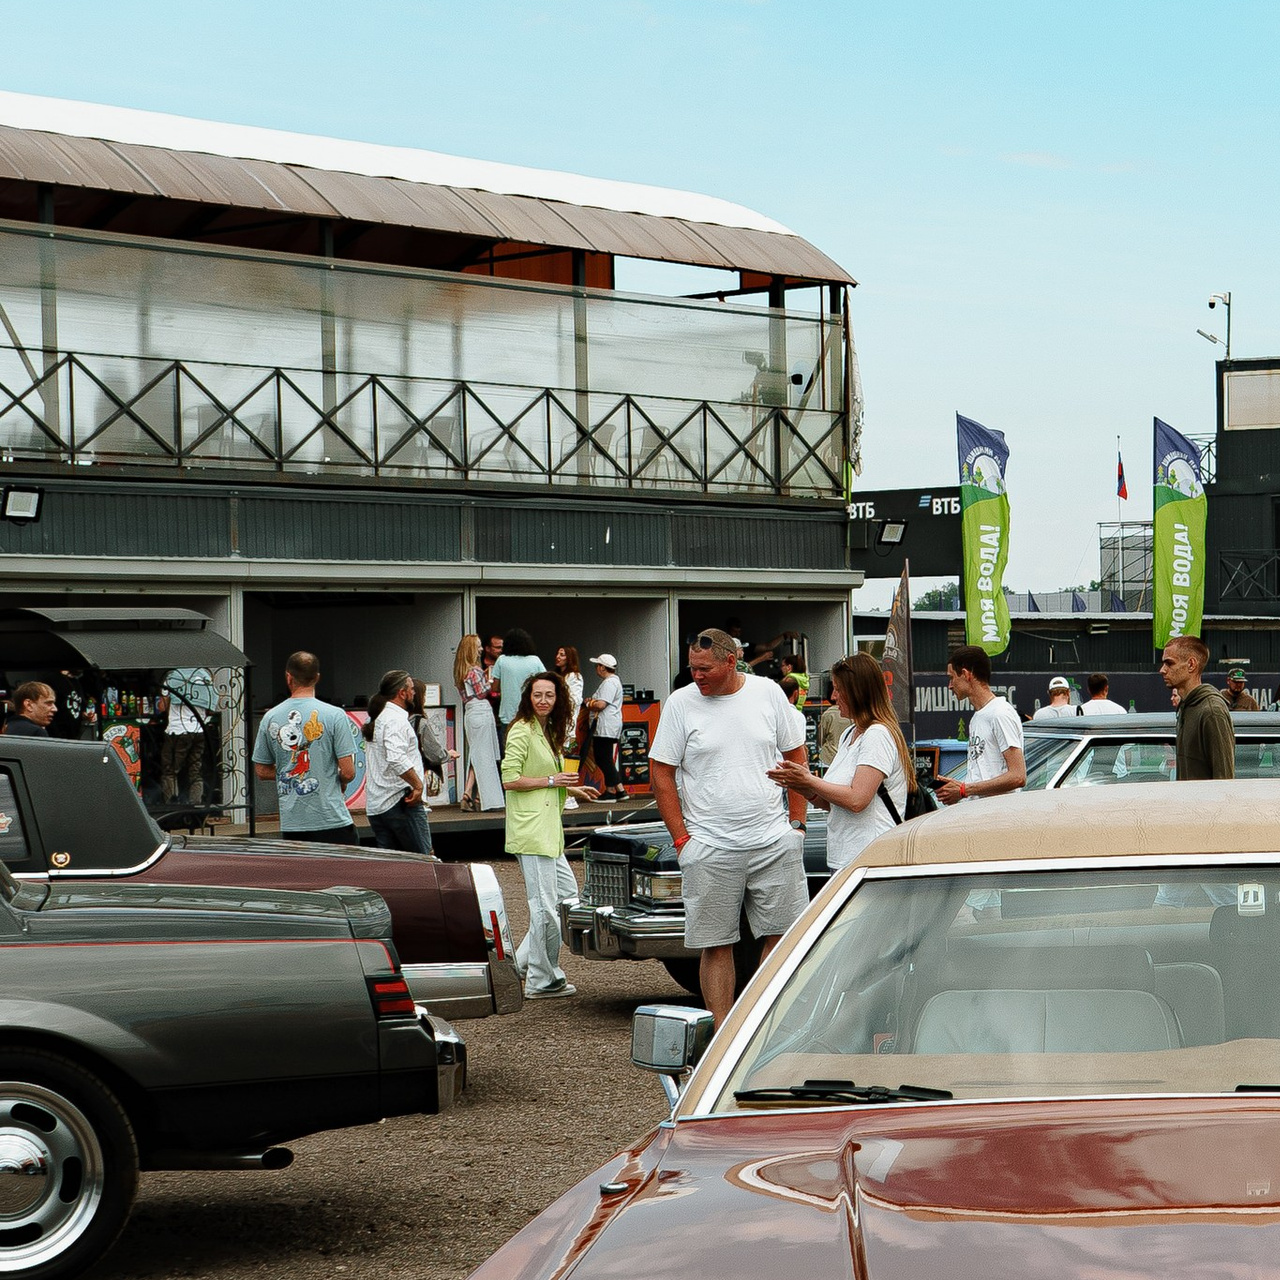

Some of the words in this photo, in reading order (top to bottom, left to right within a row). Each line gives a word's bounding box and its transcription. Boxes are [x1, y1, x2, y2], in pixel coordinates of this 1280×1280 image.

[932, 496, 961, 516] ВТБ
[977, 524, 1001, 594] ВОДА!
[1172, 523, 1195, 588] ВОДА!
